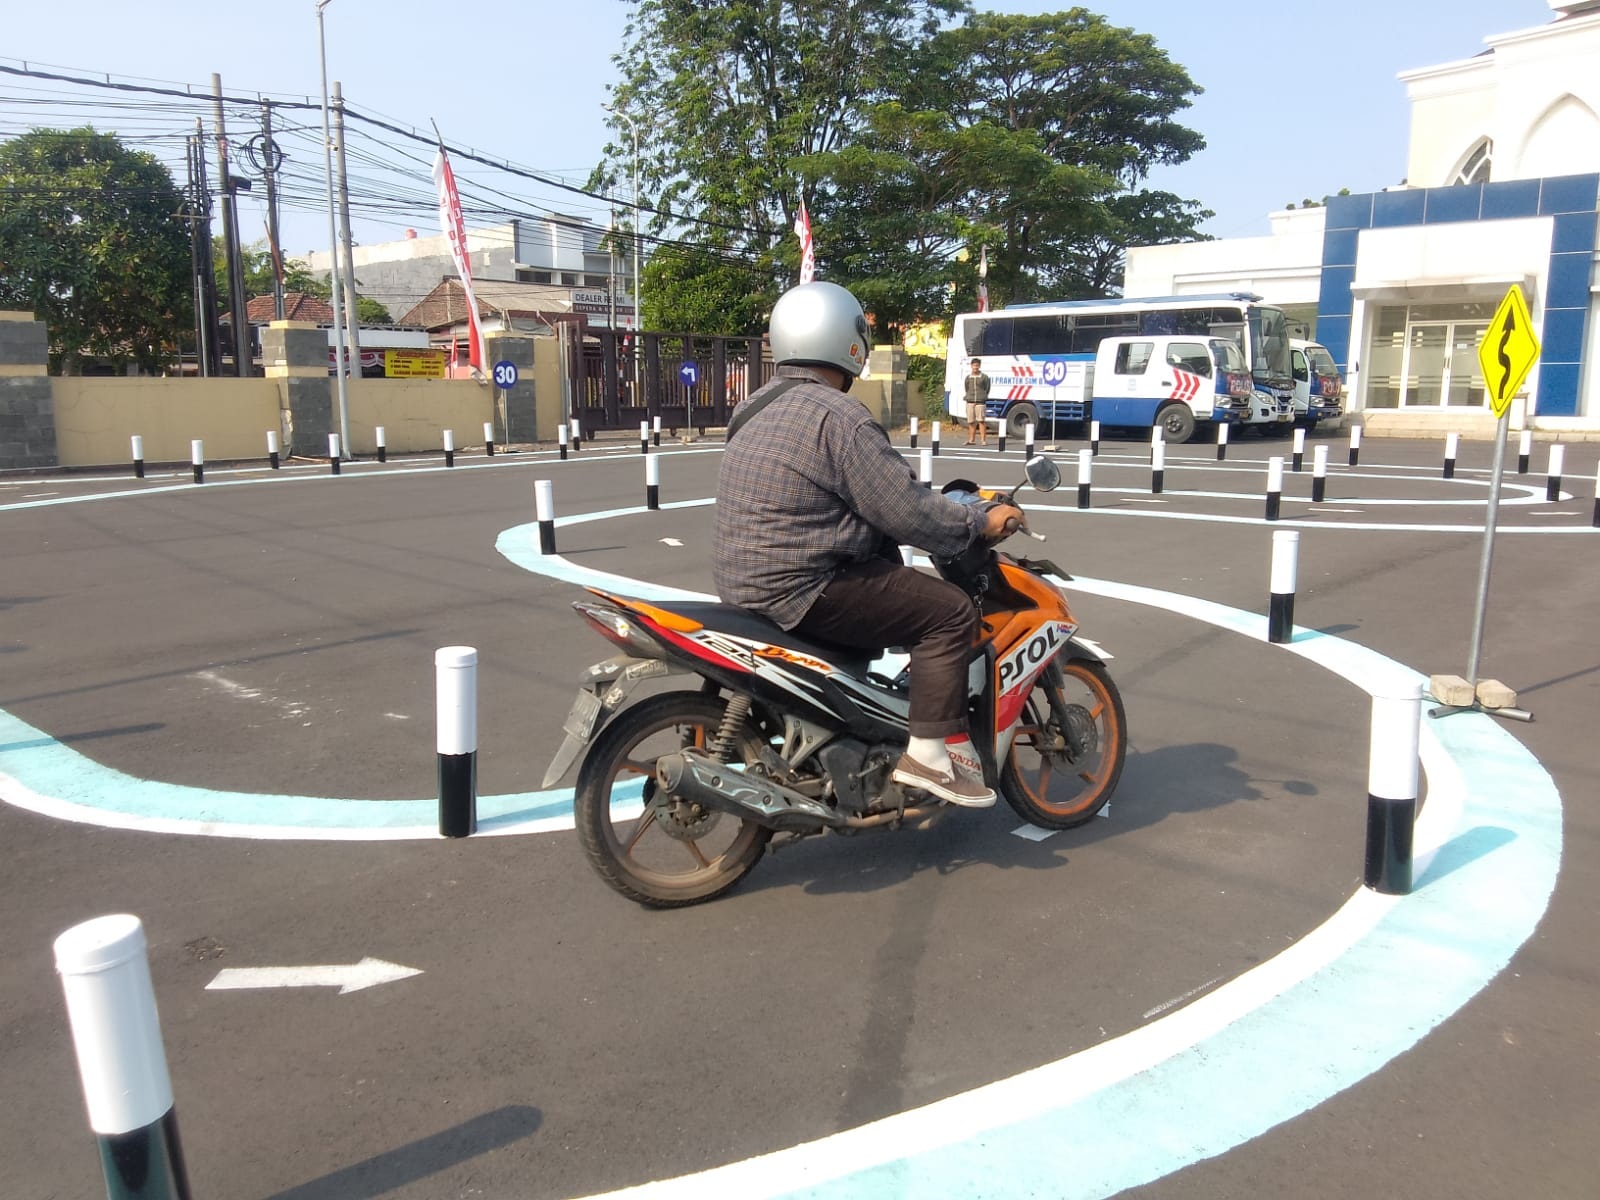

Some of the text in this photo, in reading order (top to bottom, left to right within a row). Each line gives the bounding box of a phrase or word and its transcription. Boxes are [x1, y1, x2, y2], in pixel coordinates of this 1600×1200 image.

[575, 293, 625, 304] DEALER REMI
[496, 366, 515, 384] 30
[1045, 362, 1061, 382] 30
[946, 750, 981, 771] ONDA
